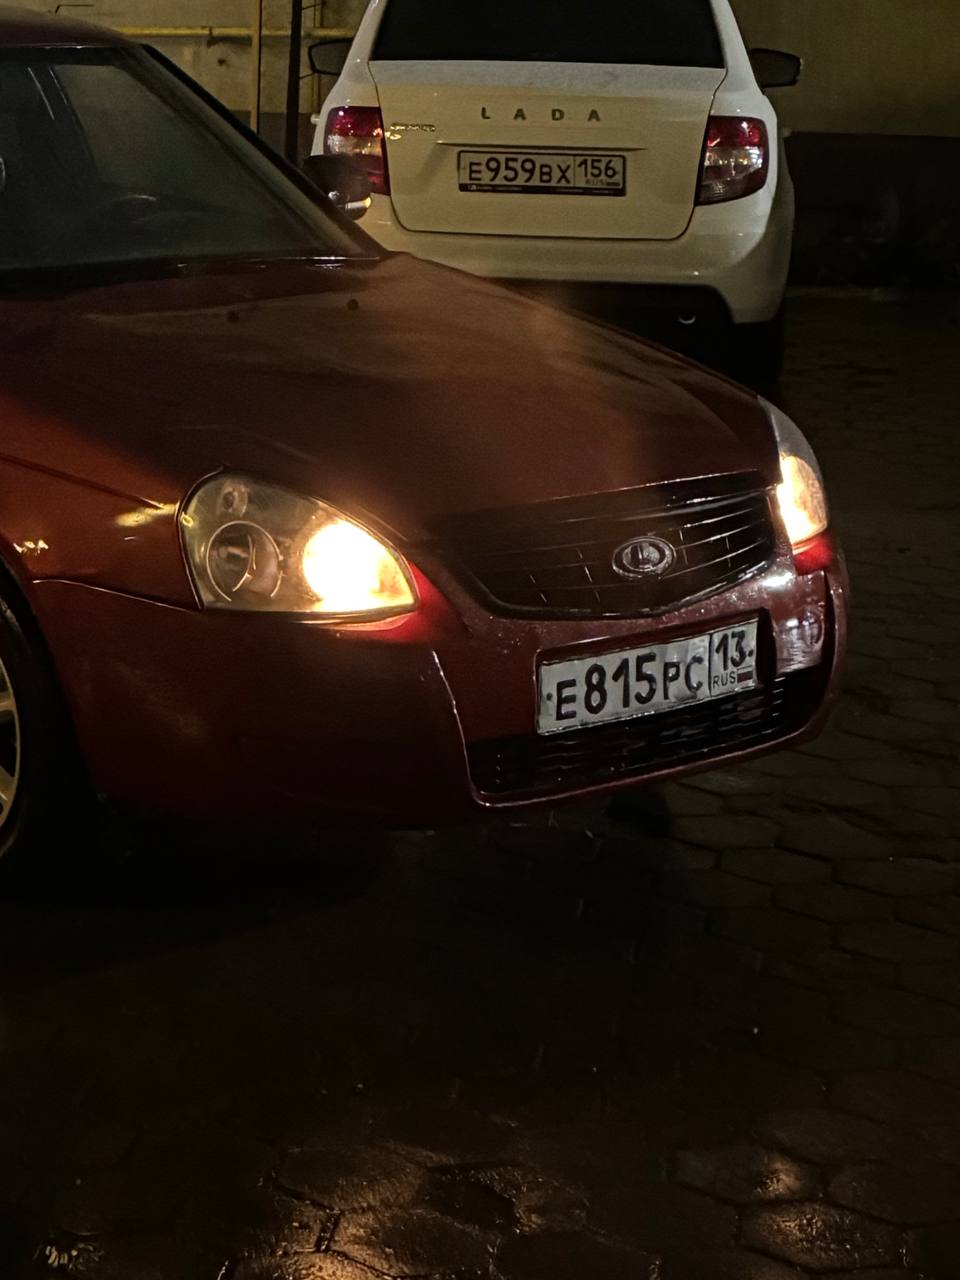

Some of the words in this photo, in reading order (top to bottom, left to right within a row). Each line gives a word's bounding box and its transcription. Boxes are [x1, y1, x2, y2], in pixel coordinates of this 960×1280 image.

[480, 106, 601, 122] LADA
[468, 157, 571, 184] Е959ВХ
[577, 158, 618, 179] 156
[555, 652, 704, 721] Е815РС
[715, 629, 748, 671] 13
[712, 670, 737, 688] RUS
